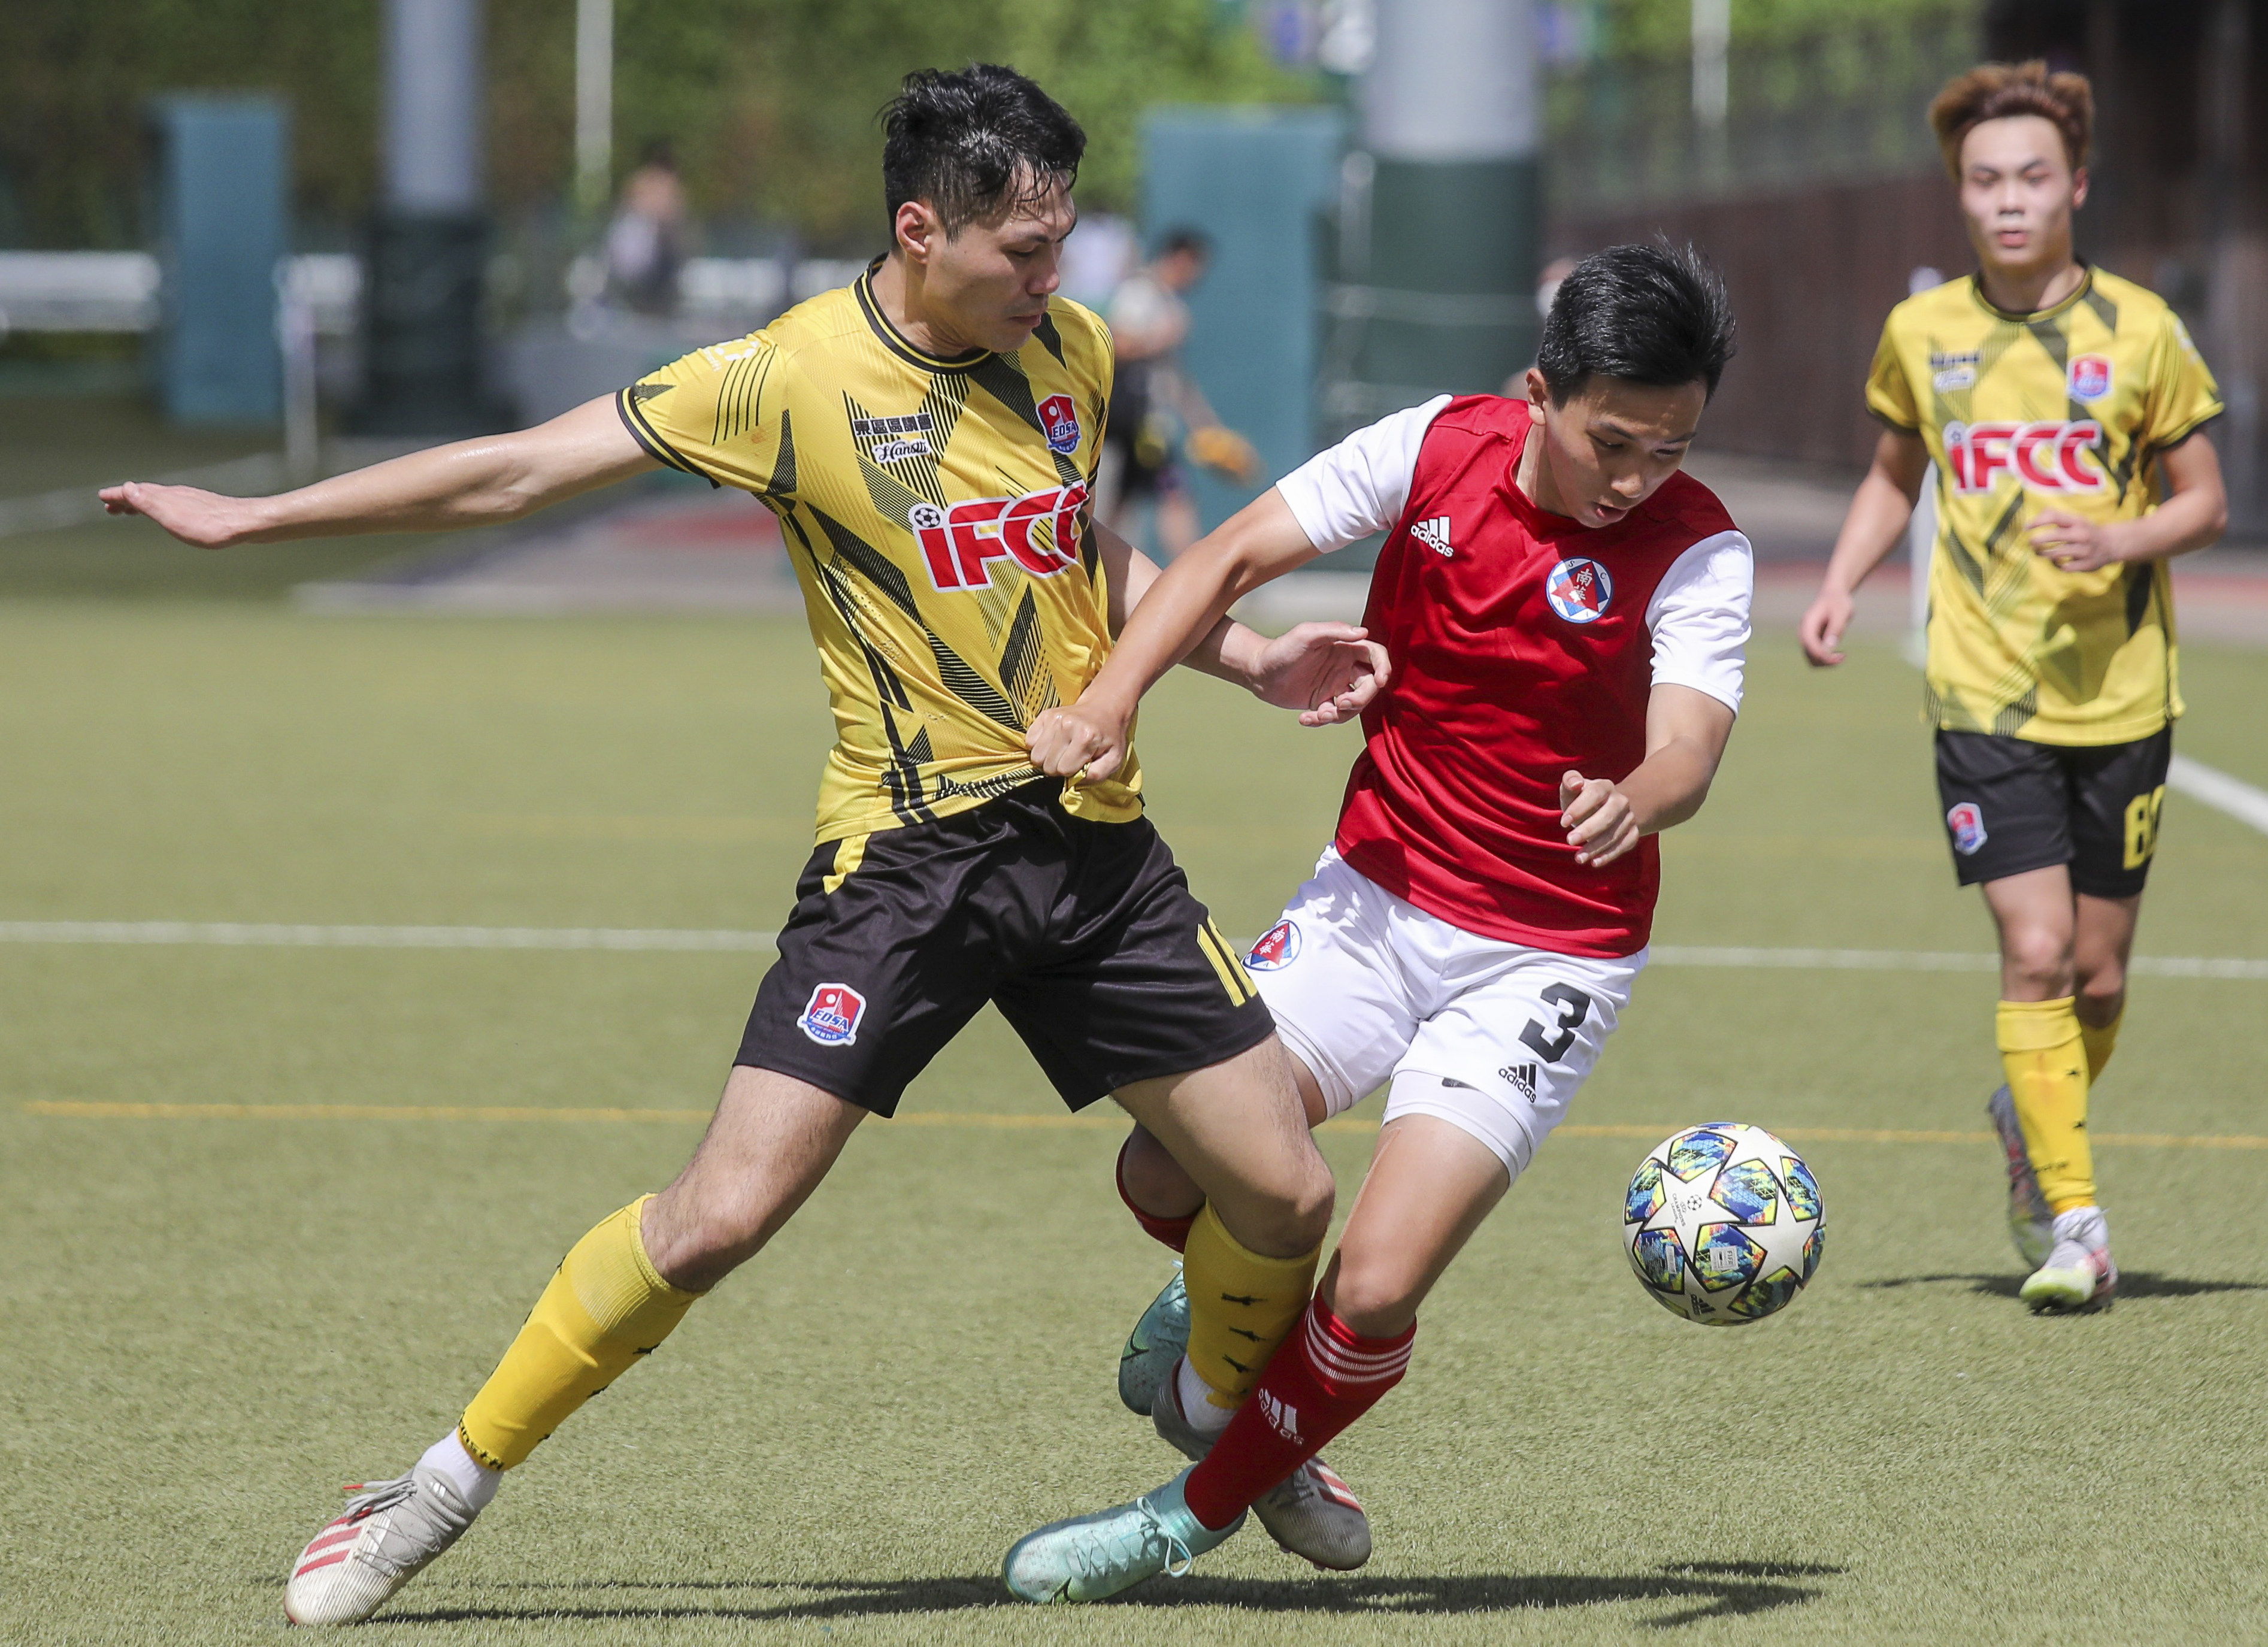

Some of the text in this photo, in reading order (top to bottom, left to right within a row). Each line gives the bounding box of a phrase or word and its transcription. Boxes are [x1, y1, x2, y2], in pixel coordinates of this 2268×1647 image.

[1052, 422, 1077, 438] EDSA
[1410, 524, 1454, 558] adidas
[813, 1010, 849, 1030] EDSA
[1518, 982, 1591, 1064] 3
[1498, 1068, 1536, 1103] adidas
[1672, 1193, 1686, 1227] CHAMPIONS
[1259, 1388, 1304, 1445] adidas
